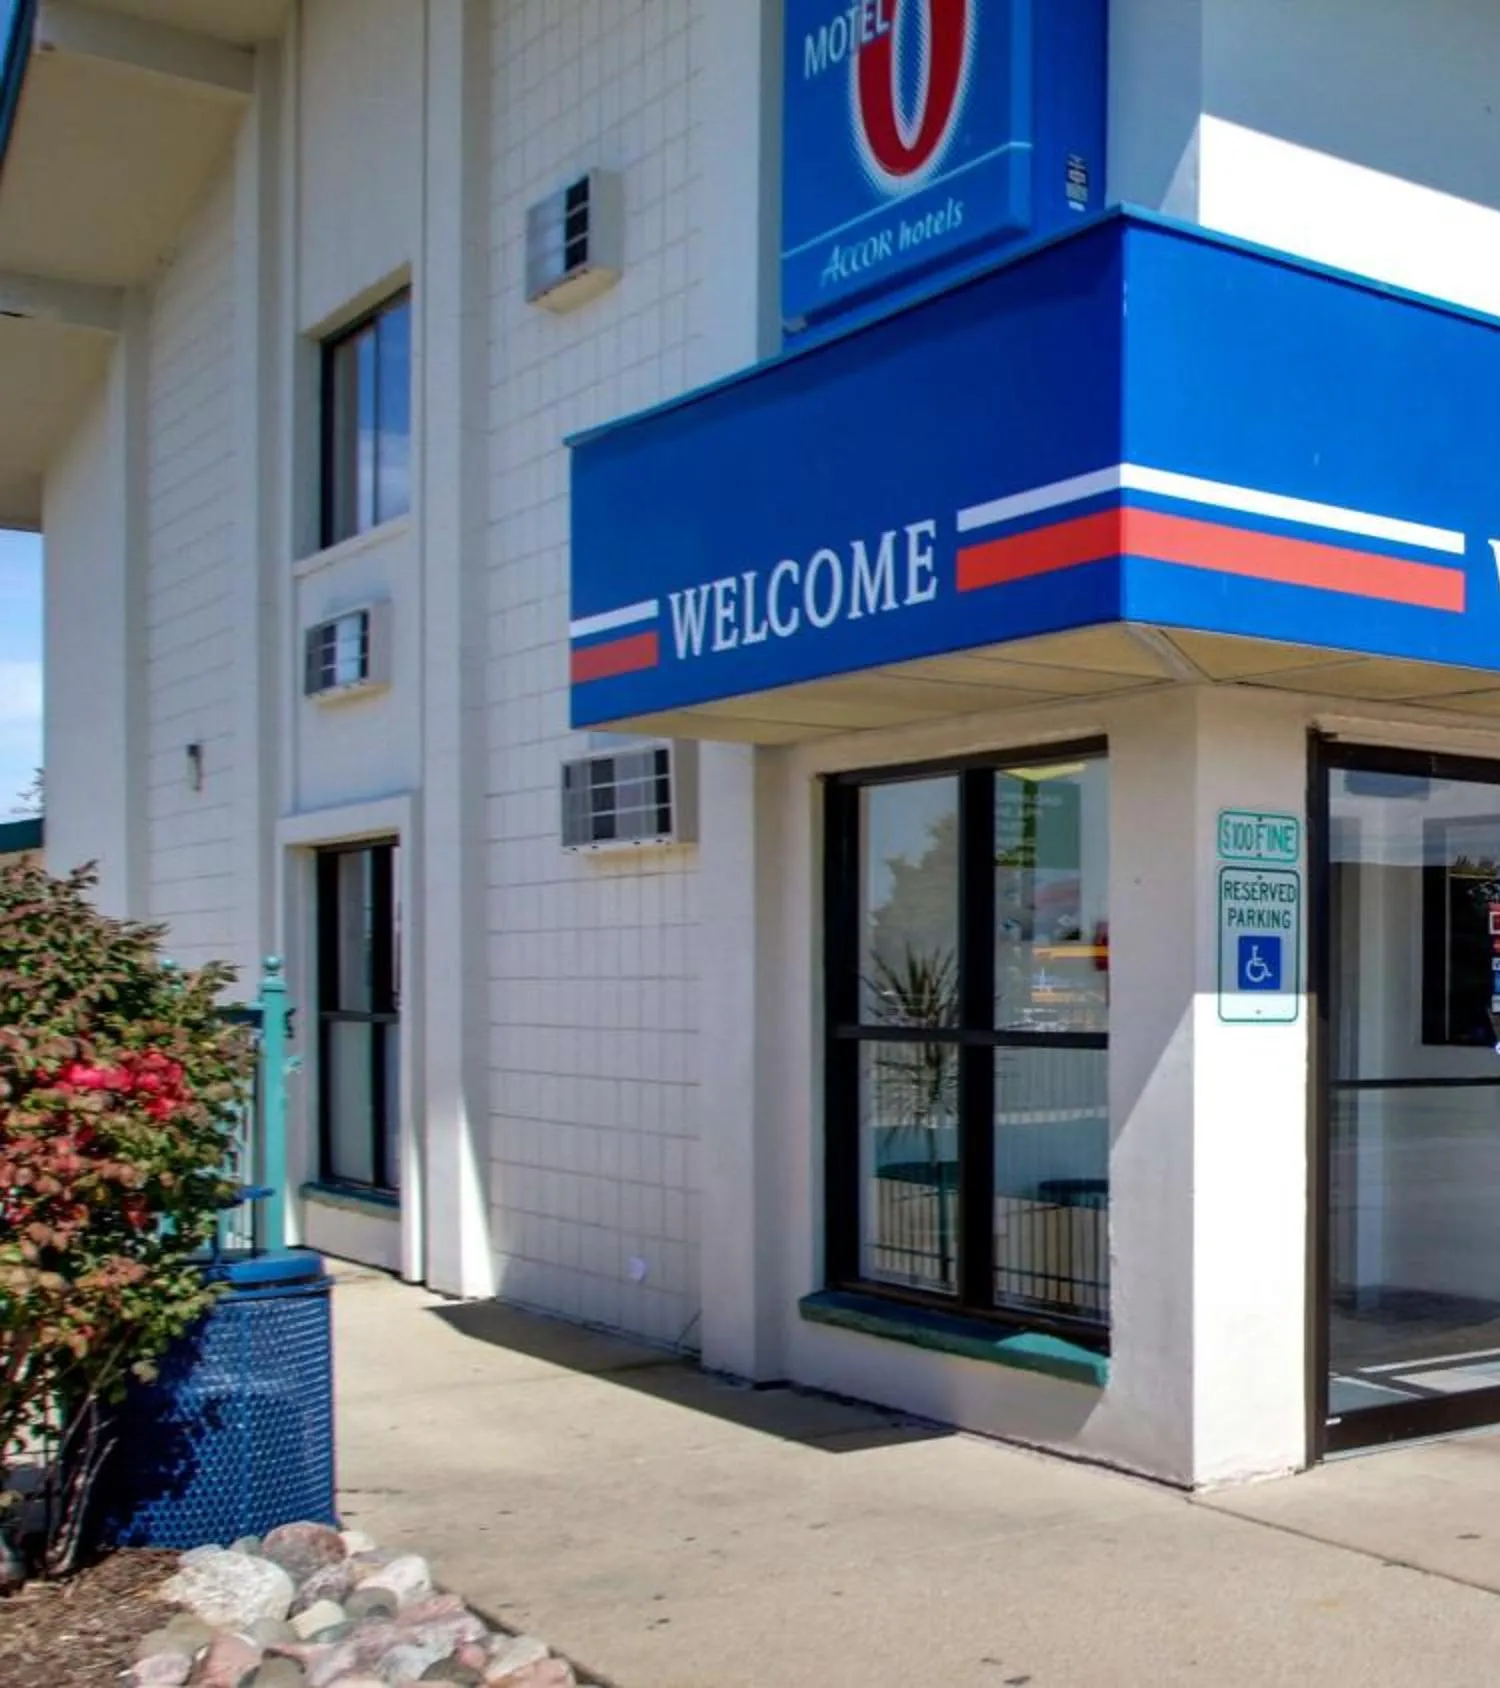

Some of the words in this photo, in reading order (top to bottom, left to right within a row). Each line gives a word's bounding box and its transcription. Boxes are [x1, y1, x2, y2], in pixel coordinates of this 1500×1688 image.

[803, 0, 892, 80] MOTEL
[898, 197, 965, 248] hotels
[667, 518, 939, 660] WELCOME
[1222, 818, 1252, 851] $100
[1255, 823, 1295, 853] FINE
[1223, 880, 1297, 903] RESERVED
[1227, 907, 1292, 930] PARKING
